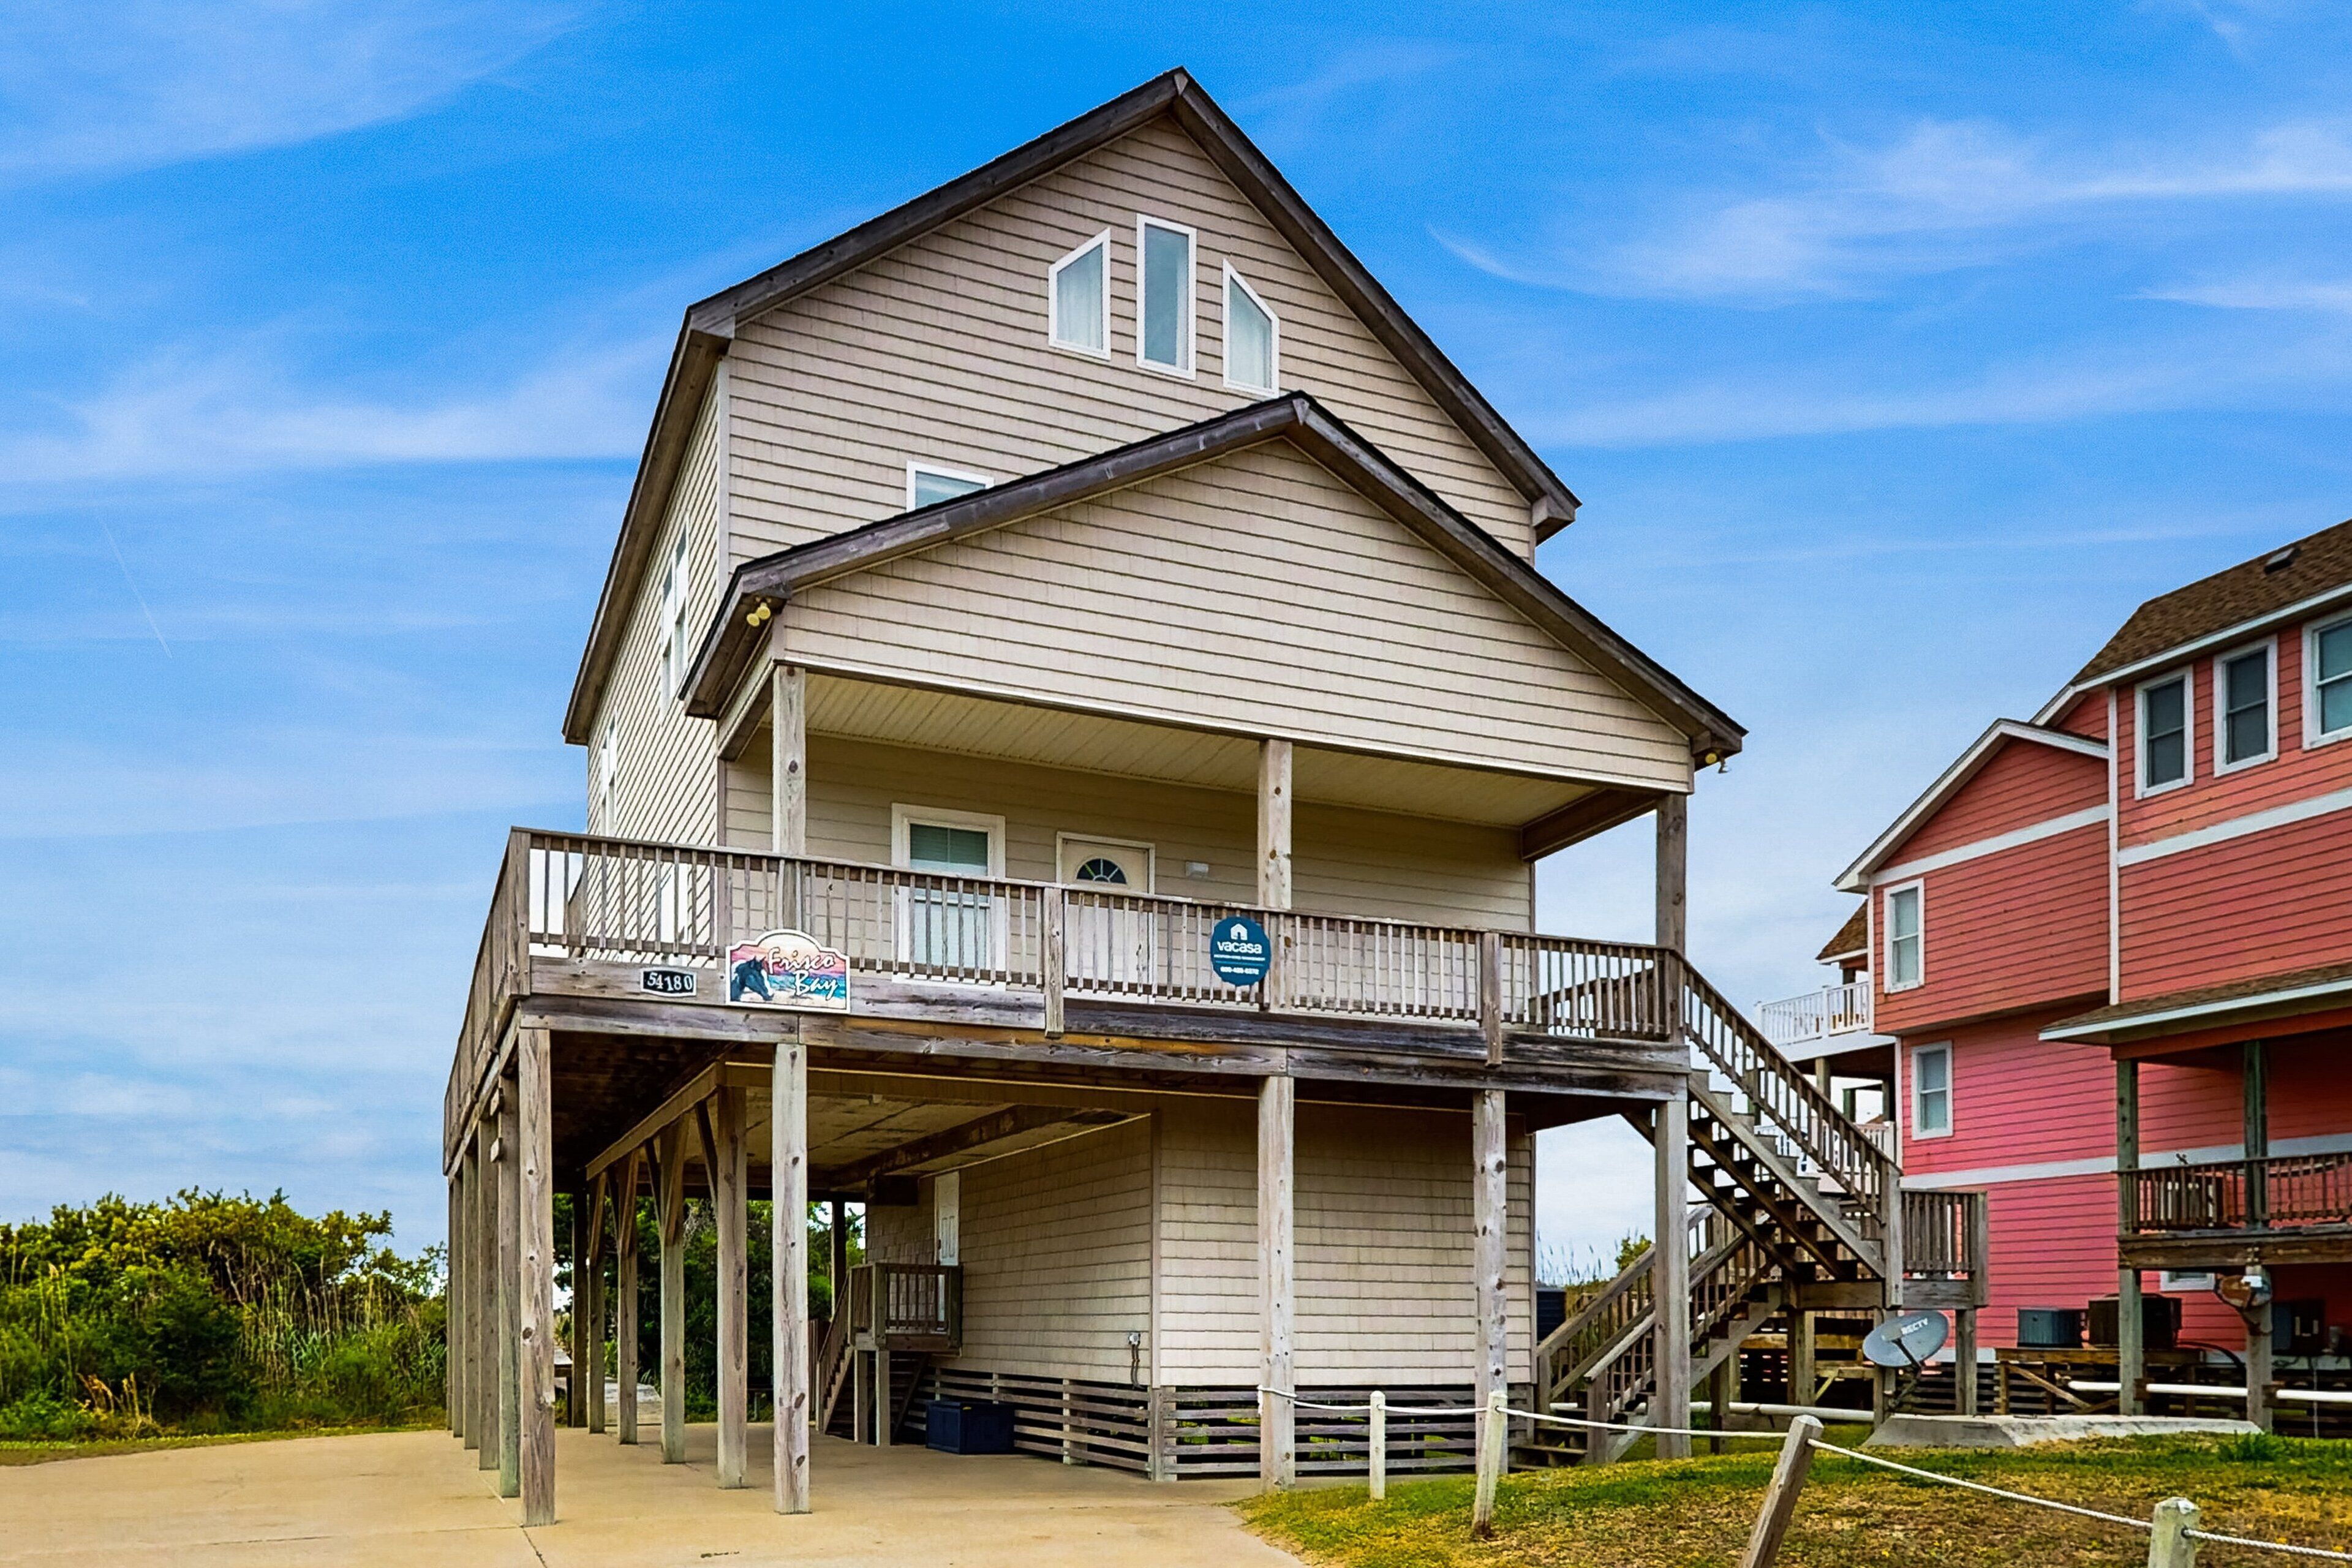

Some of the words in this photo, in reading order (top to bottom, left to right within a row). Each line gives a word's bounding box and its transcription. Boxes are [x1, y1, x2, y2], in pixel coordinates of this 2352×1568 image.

[1217, 941, 1262, 954] vacasa
[767, 947, 835, 975] Frisco
[647, 972, 693, 992] 54180
[794, 969, 838, 1001] Bay
